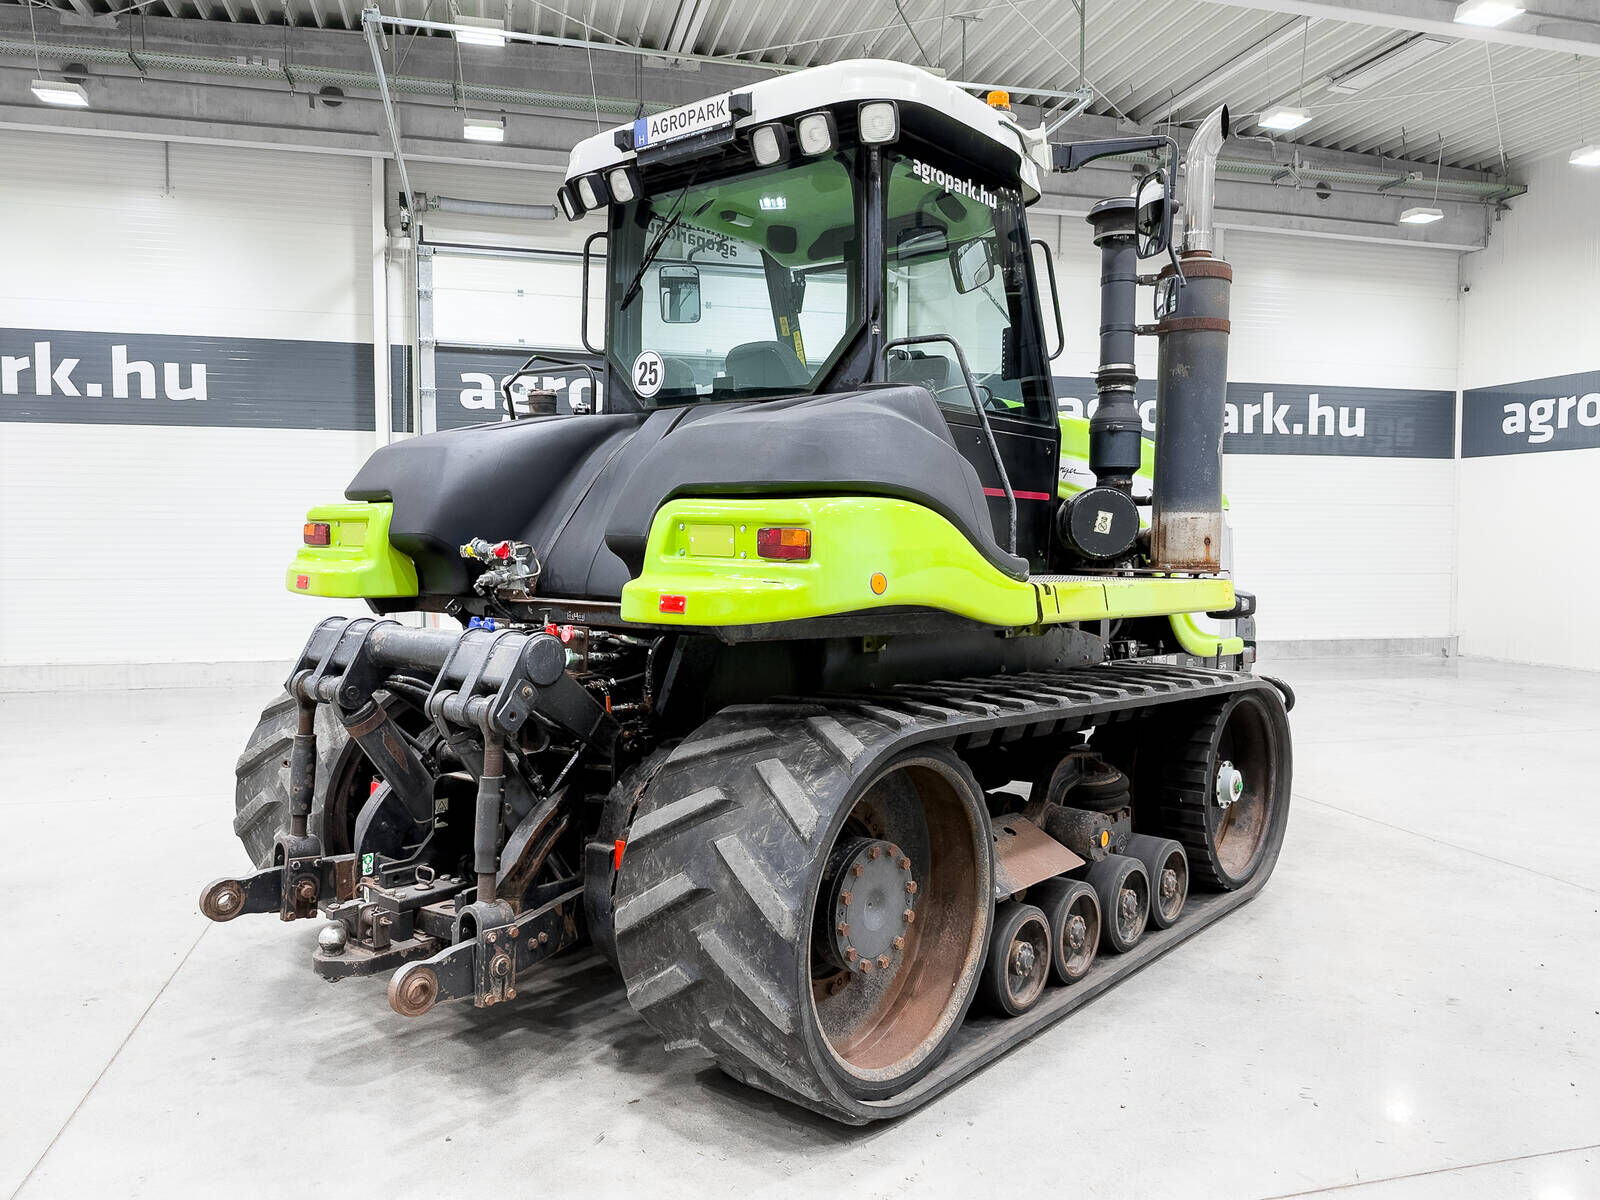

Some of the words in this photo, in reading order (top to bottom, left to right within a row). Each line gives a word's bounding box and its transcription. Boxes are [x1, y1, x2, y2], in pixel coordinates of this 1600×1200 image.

[638, 135, 645, 145] H
[651, 99, 726, 137] AGROPARK
[912, 158, 998, 209] agropark.hu
[1, 341, 208, 401] rk.hu
[637, 361, 659, 386] 25
[1502, 392, 1600, 443] agro
